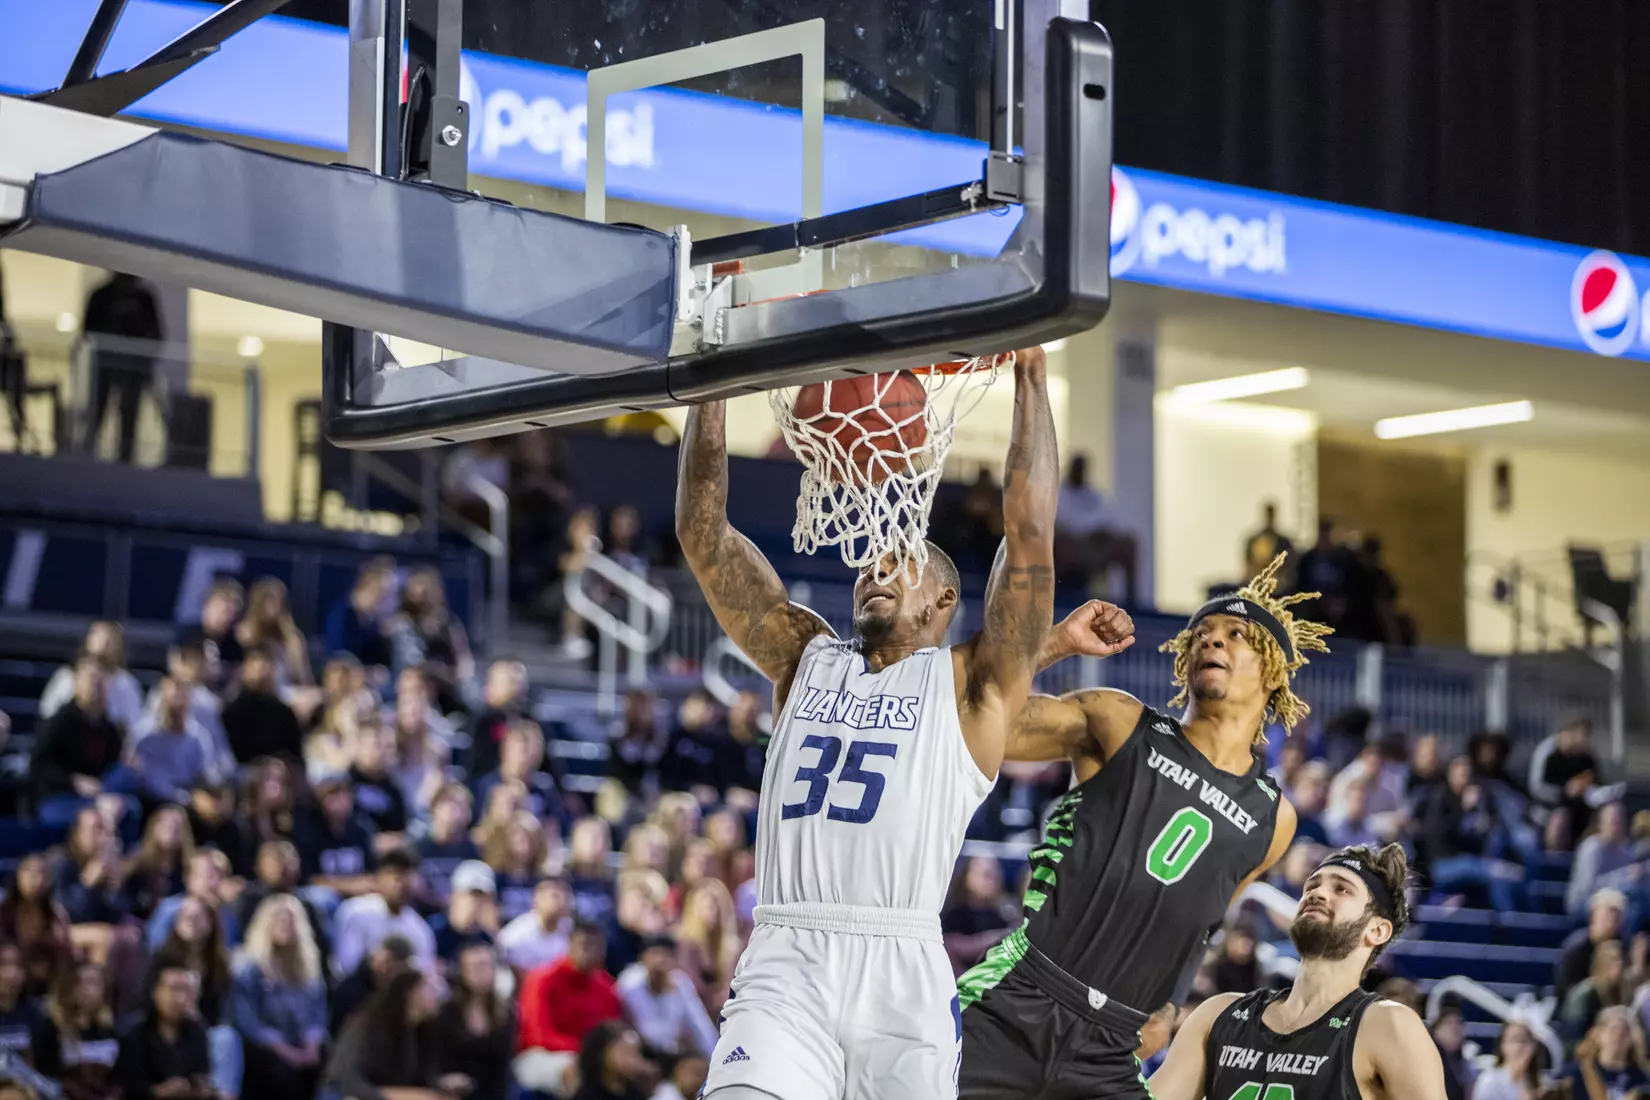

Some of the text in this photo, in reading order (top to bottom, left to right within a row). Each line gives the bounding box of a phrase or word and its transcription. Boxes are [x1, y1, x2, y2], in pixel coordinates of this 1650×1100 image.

[482, 90, 655, 173] pepsi
[1141, 204, 1286, 279] pepsi
[794, 686, 919, 731] LANCERS
[781, 734, 898, 825] 35
[1147, 746, 1200, 791] UTAH
[1199, 778, 1259, 835] VALLEY
[1145, 806, 1213, 886] 0
[1218, 1045, 1330, 1076] UTAH VALLEY
